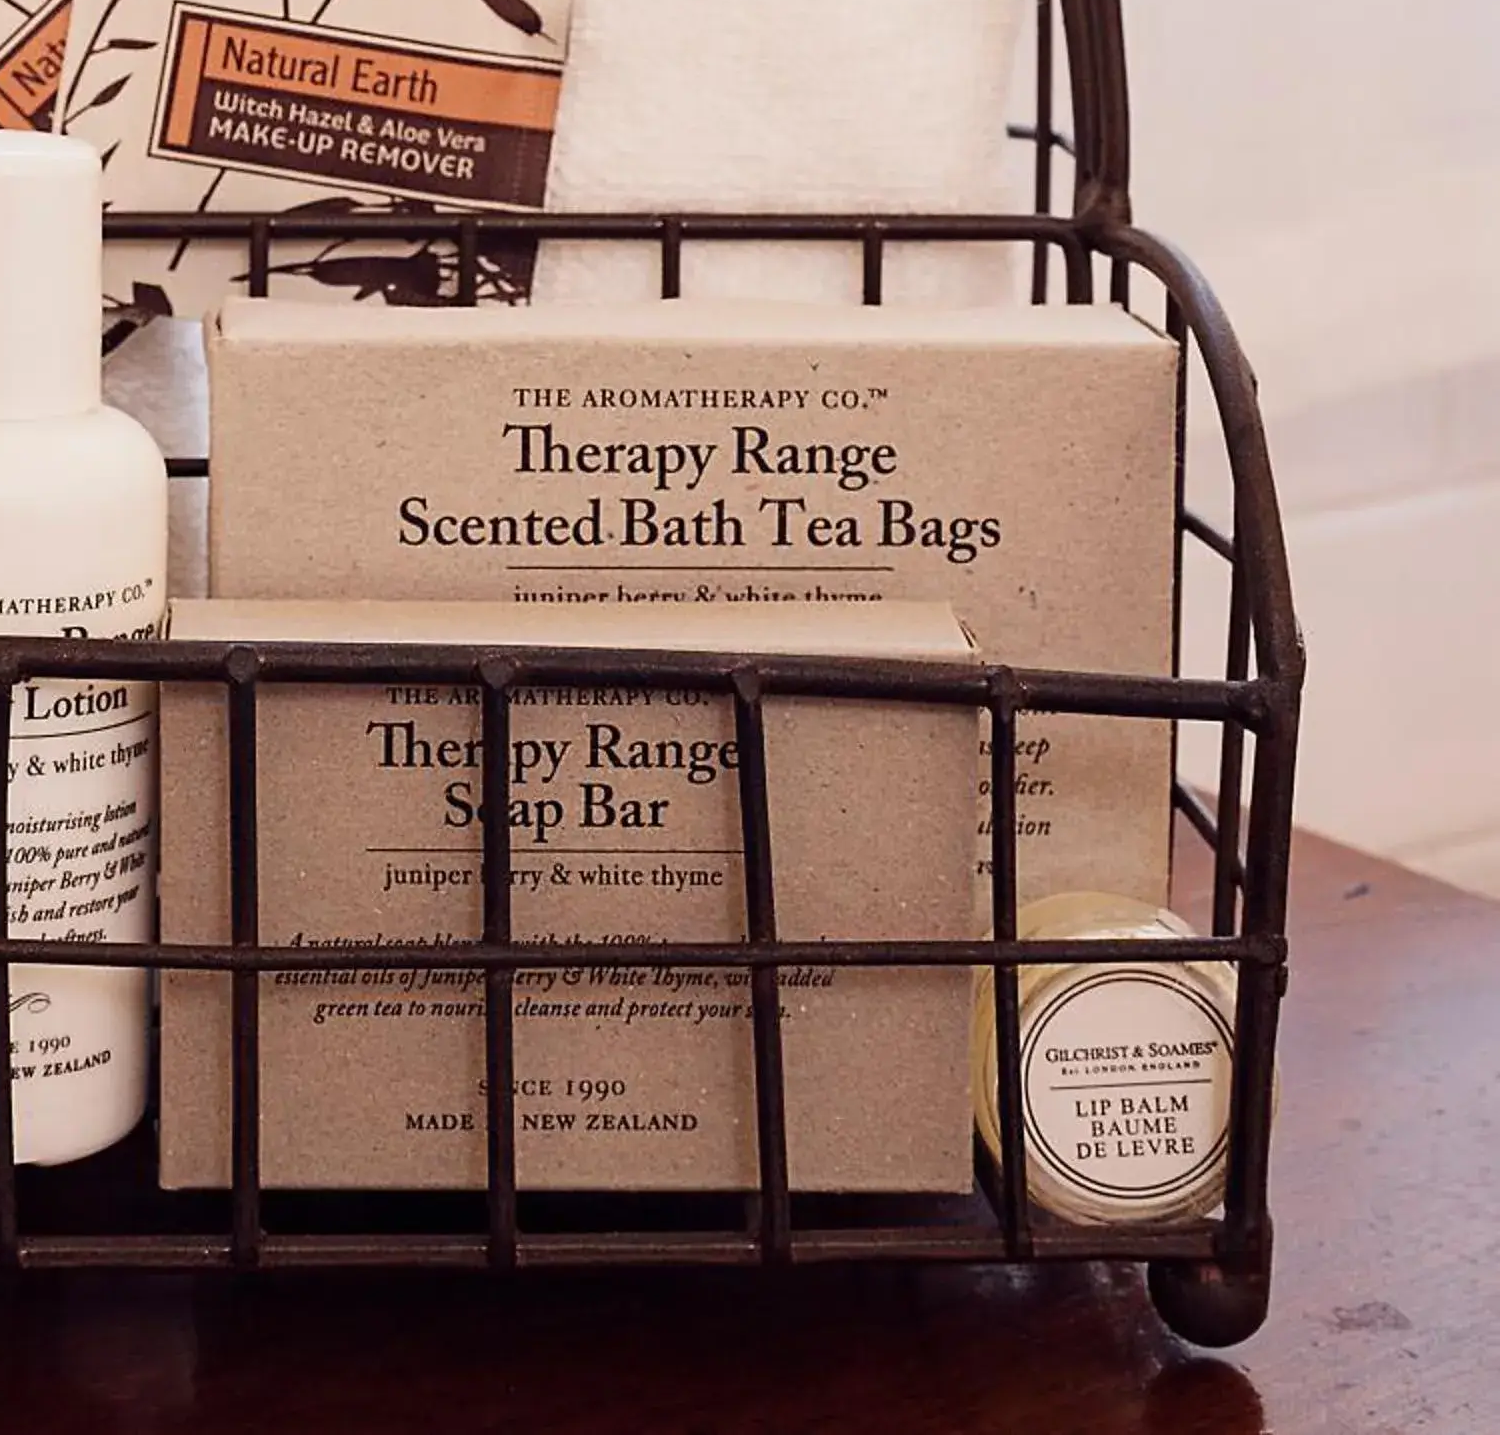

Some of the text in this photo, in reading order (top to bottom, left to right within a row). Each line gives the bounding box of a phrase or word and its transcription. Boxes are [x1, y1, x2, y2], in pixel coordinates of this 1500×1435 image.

[11, 38, 66, 97] Nat
[222, 36, 438, 104] Natural Earth
[213, 90, 486, 153] Witch Hazel & Aloe Vera
[209, 116, 476, 180] MAKE-UP REMOVER
[514, 388, 572, 409] THE
[582, 388, 811, 410] AROMATHERAPY
[502, 422, 898, 493] Therapy Range
[398, 496, 1002, 563] Scented Bath Tea Bags
[24, 684, 128, 721] Lotion
[386, 687, 439, 706] THE
[448, 687, 654, 706] ARMATHERAPY
[27, 754, 46, 776] &
[53, 750, 106, 773] white
[365, 719, 740, 784] Therpy Range
[443, 780, 670, 843] Sap Bar
[54, 844, 88, 868] pure
[91, 834, 118, 856] and
[6, 875, 57, 900] uniper
[59, 870, 101, 890] Berry
[383, 863, 473, 892] juniper
[550, 864, 572, 886] &
[578, 863, 643, 886] white
[651, 864, 724, 892] thyme
[32, 900, 67, 923] and
[68, 893, 114, 917] restore
[419, 968, 488, 993] Junipe
[313, 999, 369, 1025] green
[373, 999, 403, 1017] tea
[407, 999, 426, 1016] to
[429, 996, 487, 1017] nouri
[514, 997, 583, 1017] cleanse
[585, 996, 625, 1018] and
[626, 999, 694, 1024] protect
[694, 1003, 740, 1025] your
[28, 1035, 72, 1056] 1990
[1045, 1045, 1130, 1064] GILCHRIST
[1132, 1045, 1144, 1059] &
[42, 1050, 112, 1078] ZEALAND
[566, 1078, 626, 1103] 1990
[1075, 1094, 1190, 1118] LIP BALM
[405, 1112, 699, 1133] MADE NEW ZEALAND
[1091, 1116, 1178, 1138] BAUME
[1076, 1136, 1196, 1161] DE LEVRE
